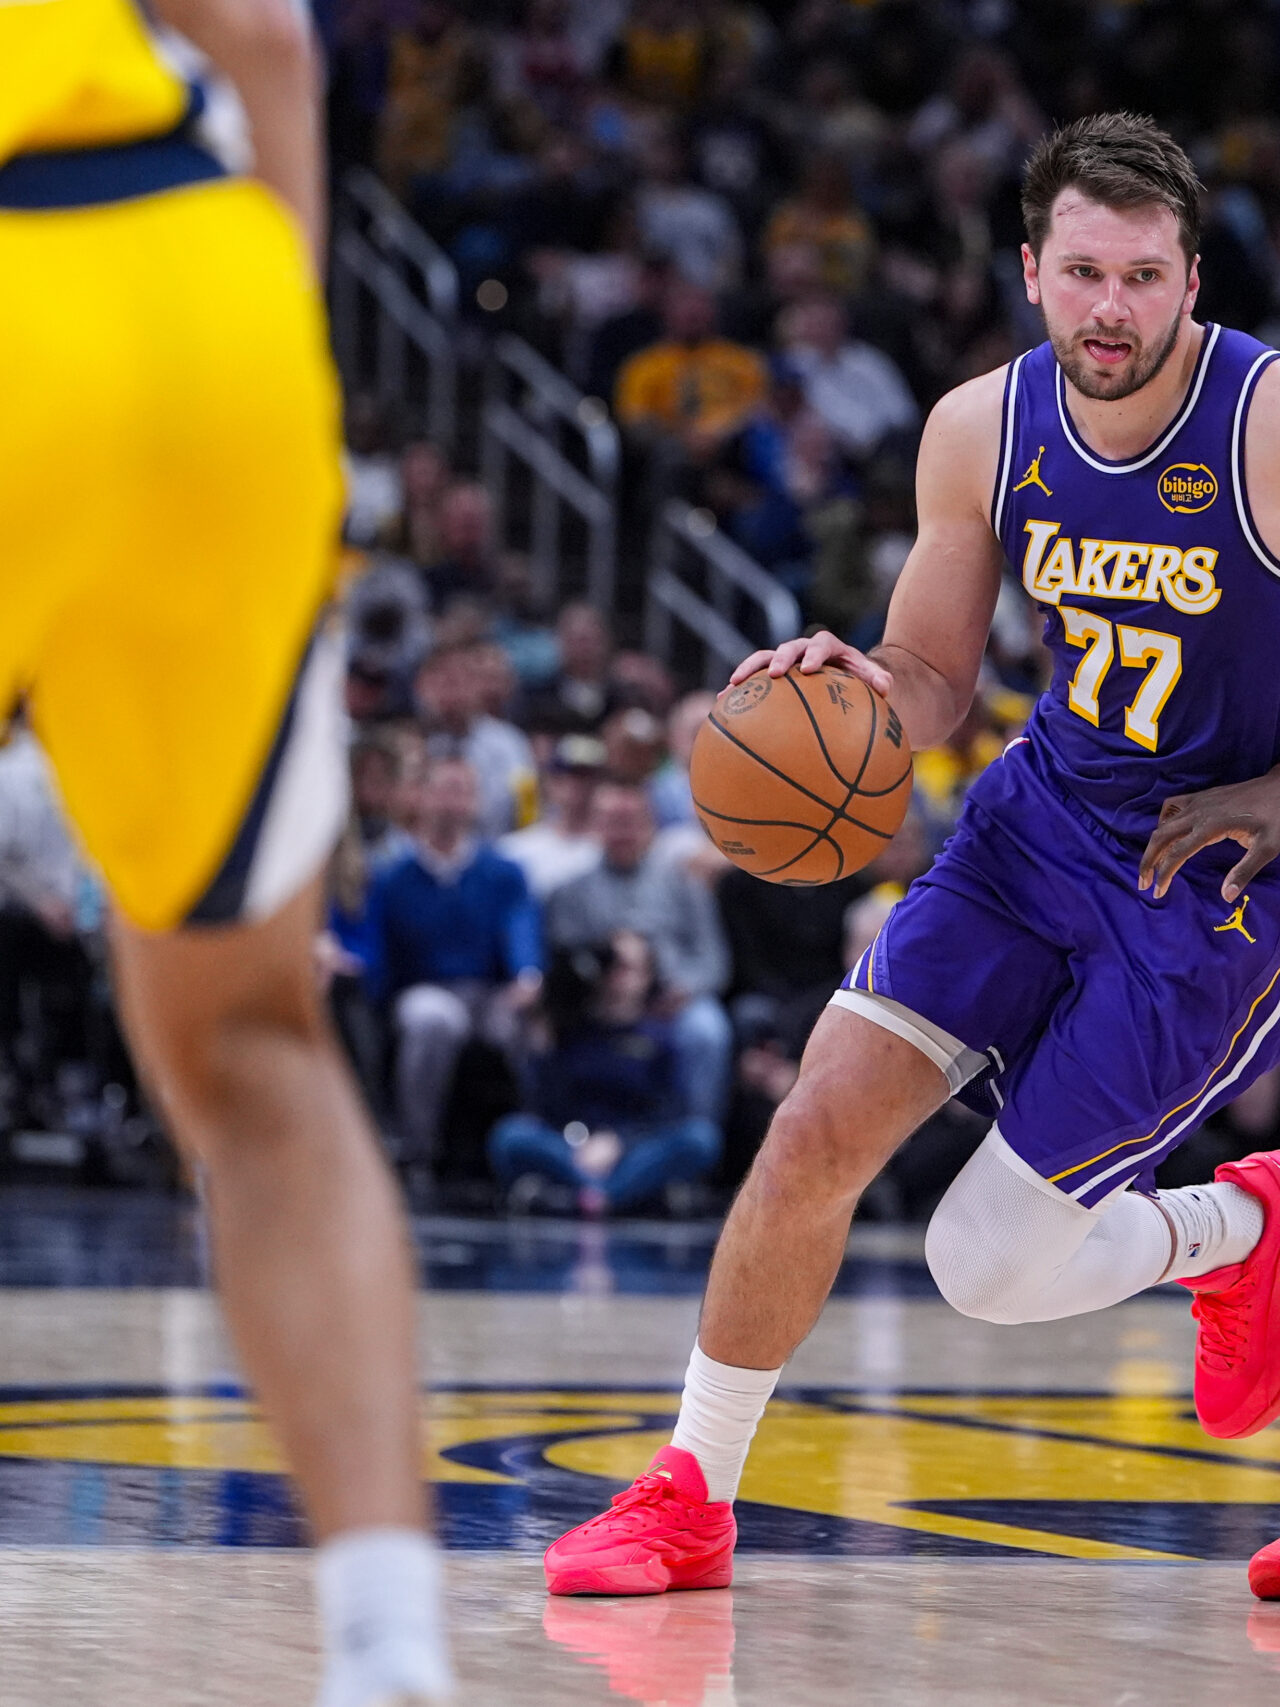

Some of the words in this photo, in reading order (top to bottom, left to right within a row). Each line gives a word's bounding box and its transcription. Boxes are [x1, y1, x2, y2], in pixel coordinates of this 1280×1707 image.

[1163, 476, 1214, 499] bibigo
[1022, 519, 1223, 615] LAKERS
[1056, 605, 1183, 753] 77
